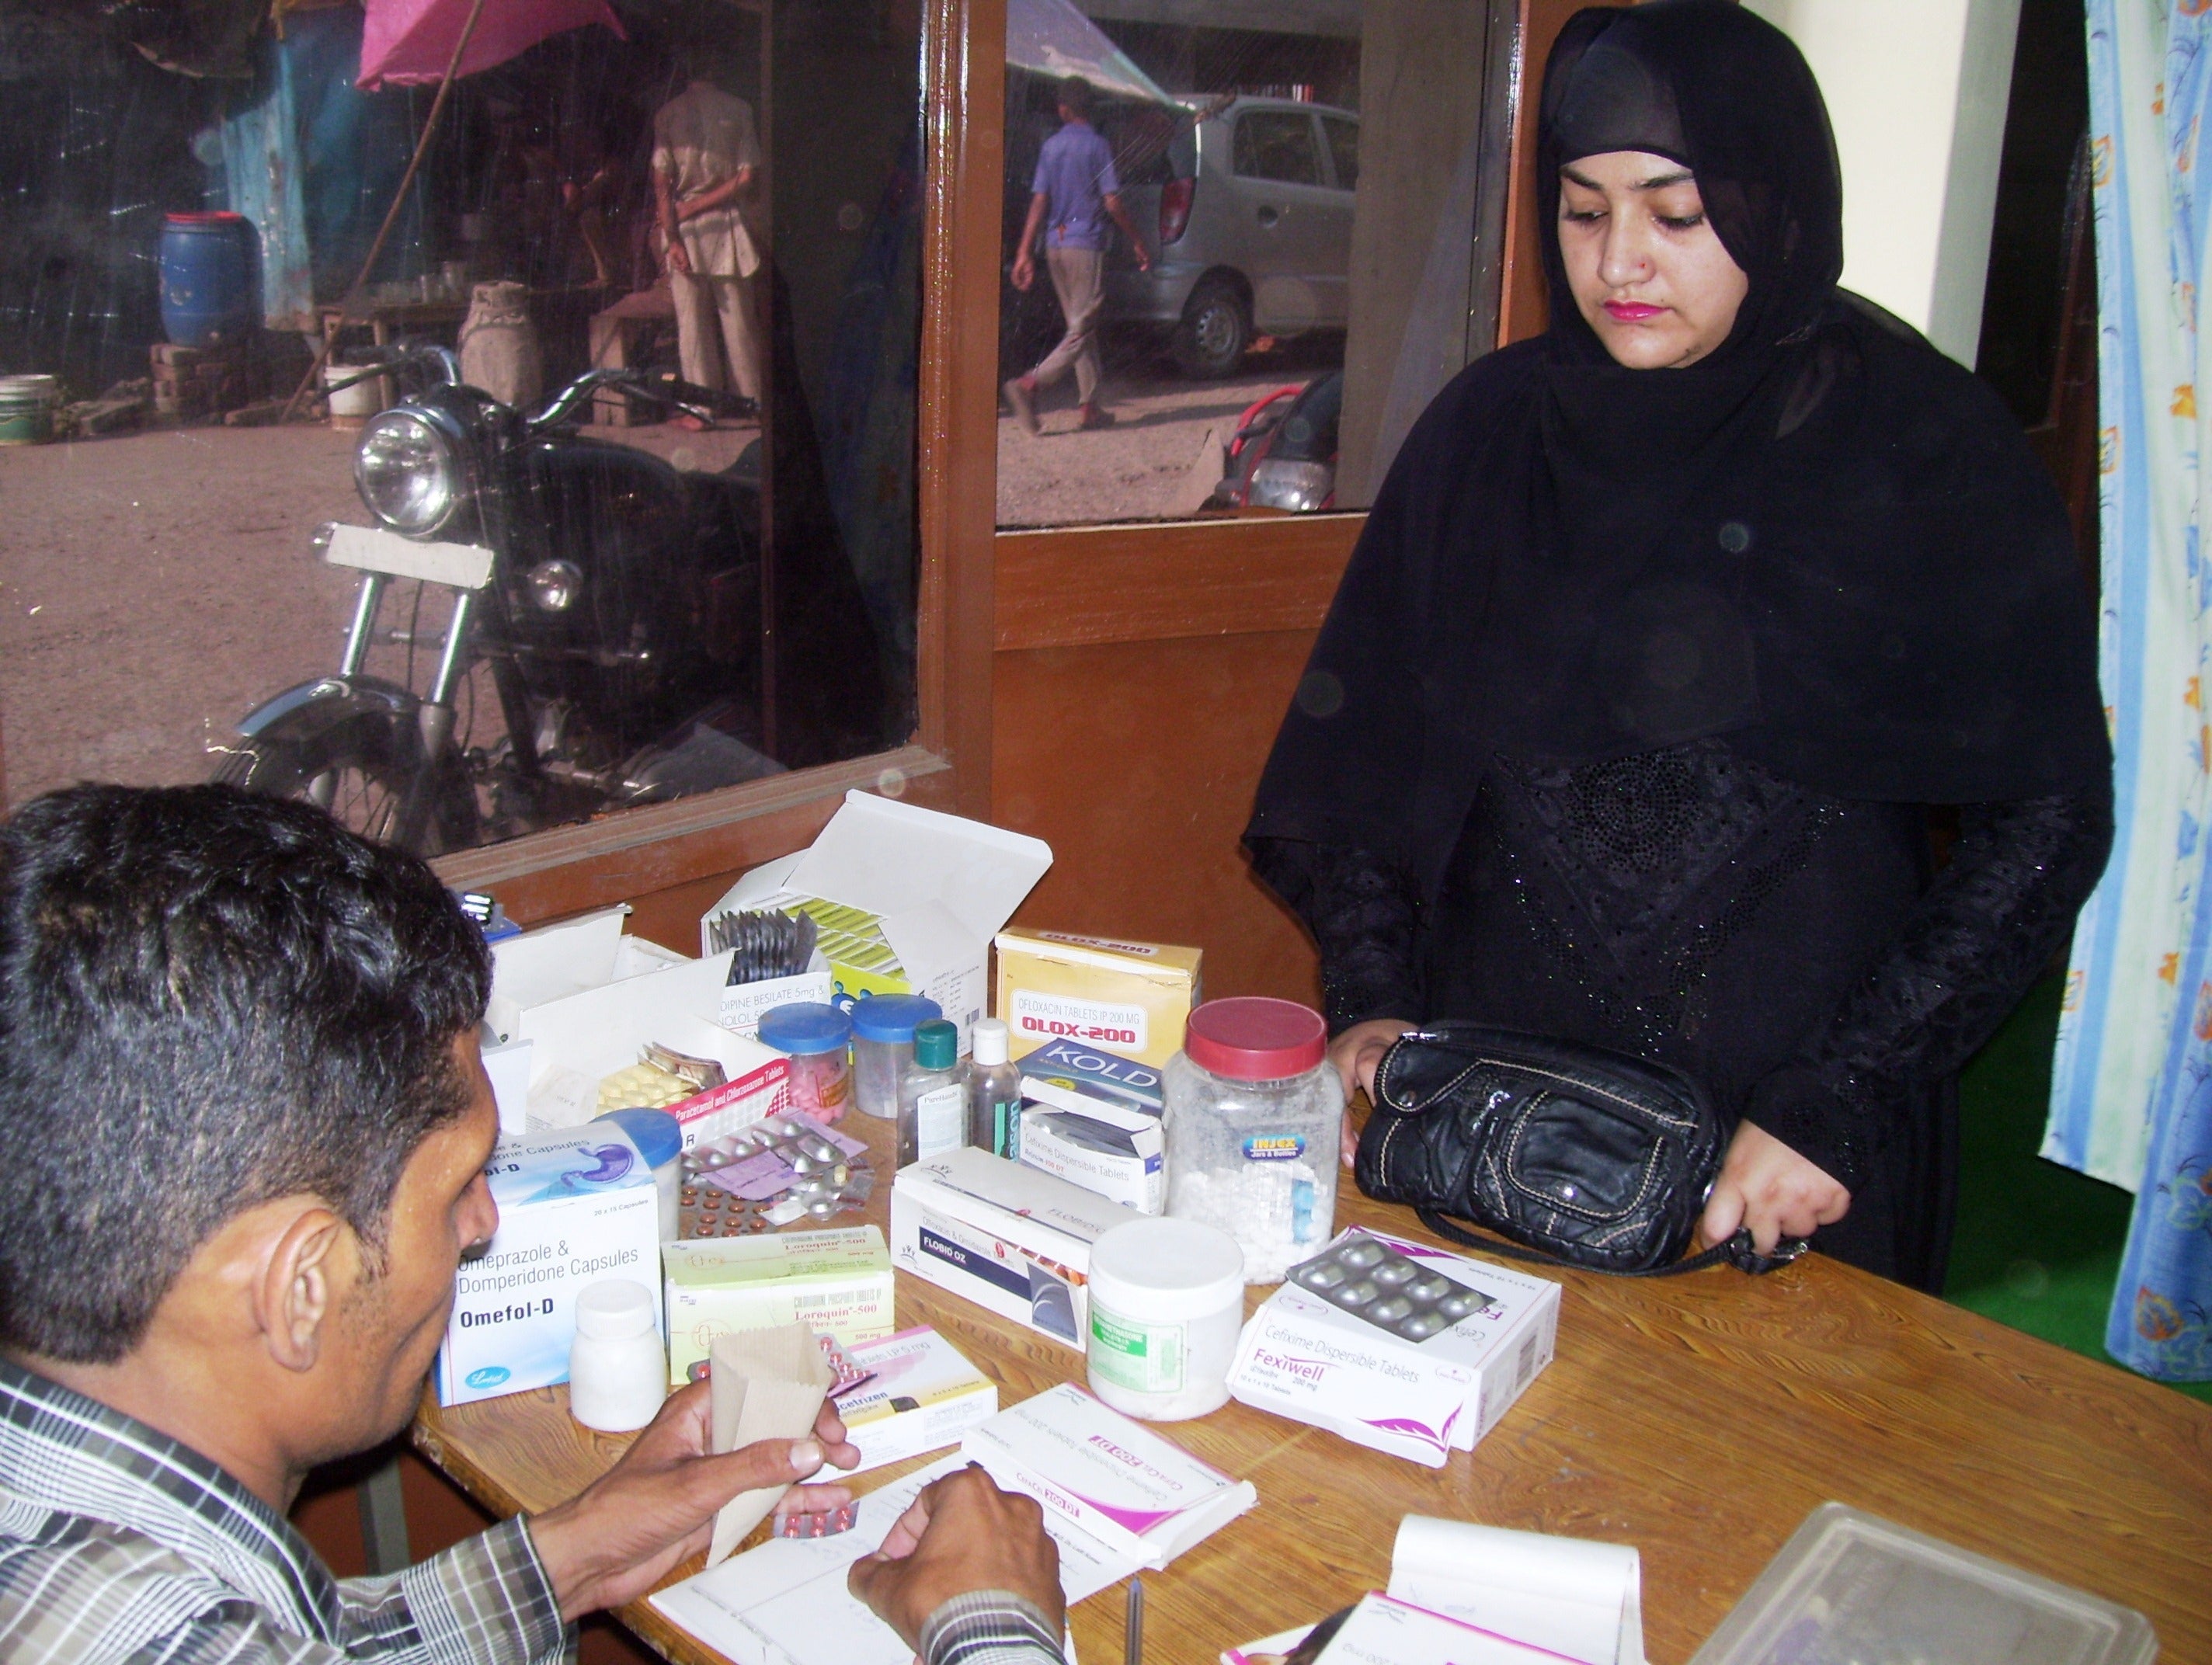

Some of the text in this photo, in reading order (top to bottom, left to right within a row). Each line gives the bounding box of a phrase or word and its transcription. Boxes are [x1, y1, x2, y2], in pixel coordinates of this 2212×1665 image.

[1045, 933, 1152, 954] OLOX-200
[754, 989, 792, 1006] BESILATE
[795, 988, 815, 1000] 5mg
[818, 985, 824, 995] &
[1018, 998, 1139, 1024] OFLOXACIN TABLETS IP 200 MG
[1022, 1016, 1136, 1044] OLOX-200
[1045, 1045, 1157, 1087] KOLD
[675, 1095, 714, 1121] Paracetamol
[715, 1093, 725, 1107] and
[764, 1065, 784, 1083] Tablets
[526, 1138, 590, 1156] Capsules
[1054, 1149, 1096, 1173] Dispersible
[1098, 1166, 1129, 1181] Tablets
[618, 1199, 649, 1211] Capsules
[458, 1240, 569, 1272] Omeprazole &
[923, 1236, 967, 1264] FLOBID OZ
[459, 1249, 638, 1295] Domperidone Capsules
[461, 1298, 554, 1328] Omefol-D
[1254, 1347, 1325, 1382] Fexiwell
[1265, 1324, 1313, 1350] Cefixime
[1315, 1340, 1377, 1370] Dispersible
[1379, 1360, 1419, 1384] Tablets
[1292, 1375, 1318, 1392] 200 mg
[838, 1390, 889, 1412] cetrizen
[1046, 1490, 1064, 1508] 200
[1064, 1500, 1080, 1517] DT
